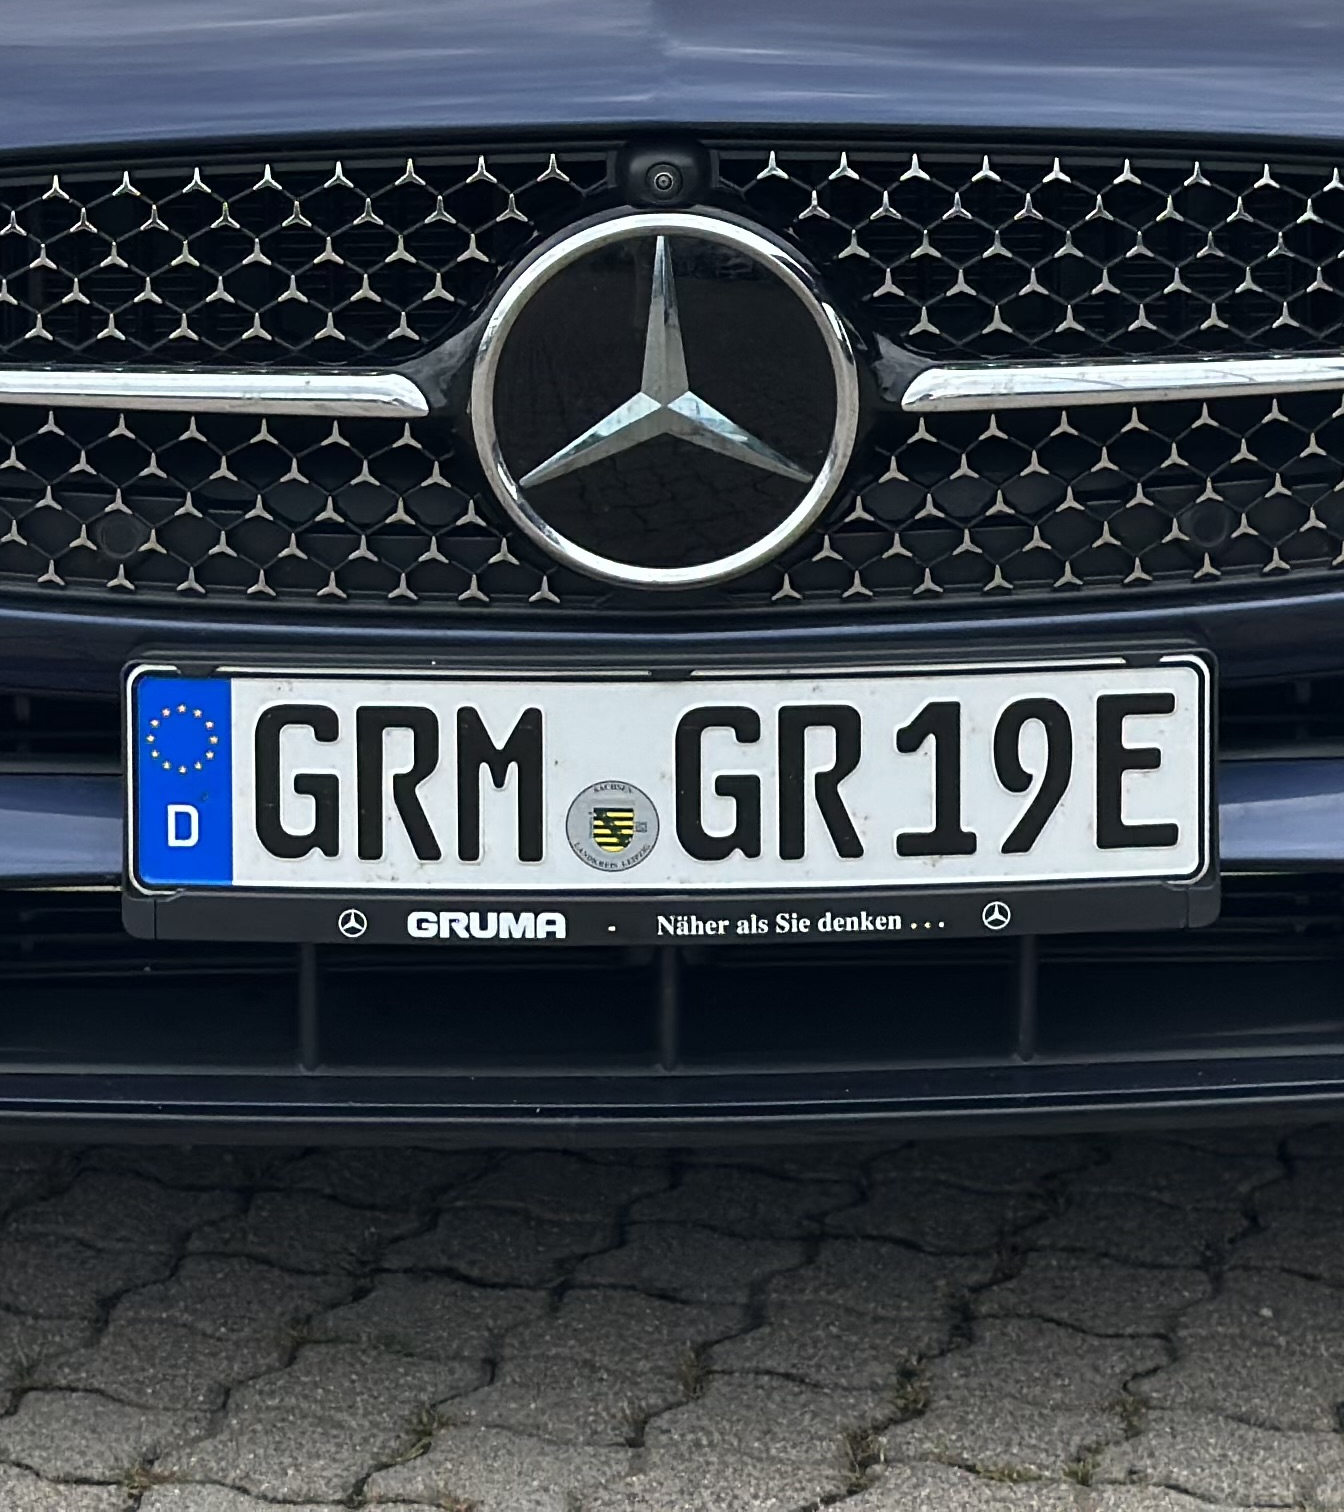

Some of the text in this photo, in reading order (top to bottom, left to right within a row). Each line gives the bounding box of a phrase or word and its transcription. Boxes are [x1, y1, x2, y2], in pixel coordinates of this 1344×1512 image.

[255, 704, 543, 862] GRM
[168, 805, 198, 846] D
[407, 912, 566, 938] GRUMA
[657, 913, 729, 935] Näher
[737, 914, 768, 934] als
[776, 912, 810, 933] Sie
[818, 911, 901, 932] denken
